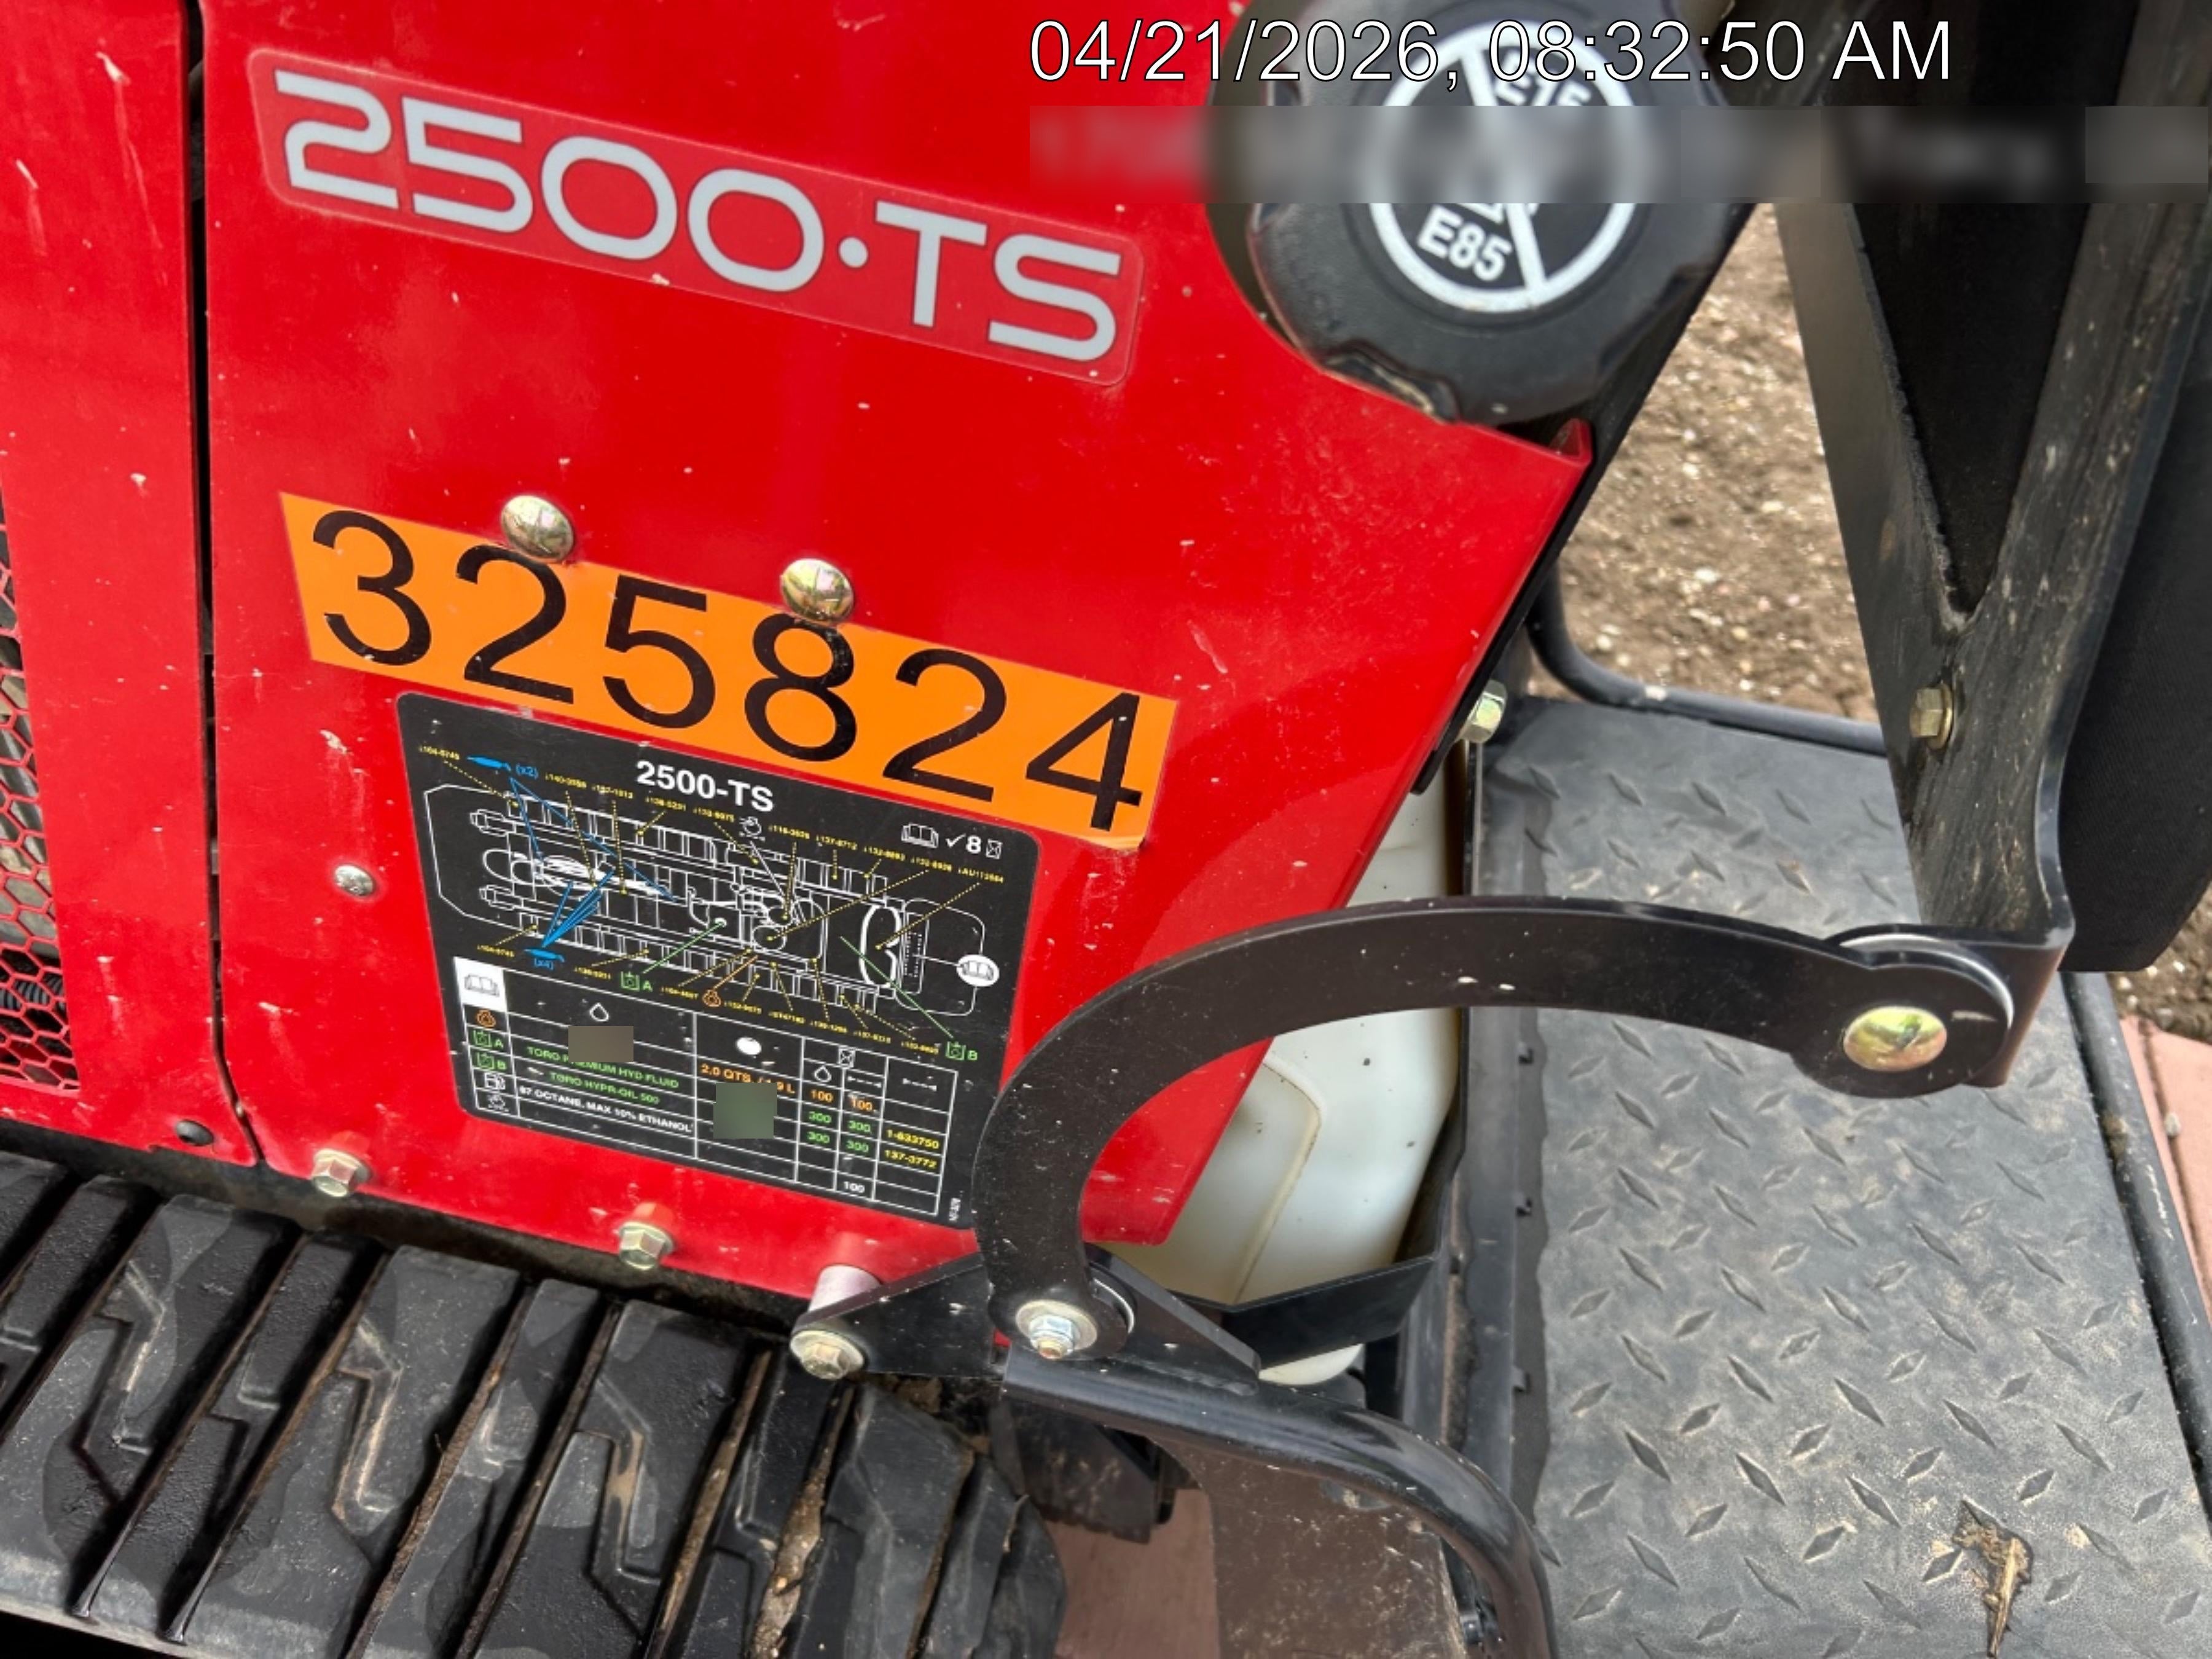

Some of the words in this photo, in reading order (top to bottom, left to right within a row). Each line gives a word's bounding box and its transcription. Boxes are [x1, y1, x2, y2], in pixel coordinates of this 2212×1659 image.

[1416, 205, 1513, 281] E85
[312, 510, 1143, 832] 325824
[516, 764, 539, 779] (x2)
[637, 759, 774, 812] 2500-TS
[965, 834, 982, 853] 8
[643, 982, 653, 992] A
[494, 1038, 504, 1049] A
[967, 1050, 978, 1061] B
[497, 1059, 507, 1070] B
[527, 1046, 560, 1062] TORO
[563, 1053, 616, 1074] EMIUM
[619, 1066, 643, 1080] HYD
[646, 1073, 680, 1089] FLUID
[700, 1063, 720, 1076] 2.0
[550, 1072, 582, 1087] TORO
[584, 1079, 638, 1099] HYPR-OIL
[640, 1092, 660, 1105] 500
[786, 1083, 796, 1094] L
[810, 1089, 833, 1103] 100
[519, 1086, 531, 1096] 87
[586, 1101, 611, 1114] MAX
[615, 1107, 637, 1120] 10%
[638, 1113, 692, 1132] ETHANOL
[850, 1096, 873, 1111] 100
[809, 1110, 831, 1124] 300
[848, 1120, 871, 1133] 300
[807, 1131, 830, 1144] 300
[846, 1140, 869, 1153] 300
[843, 1180, 865, 1193] 100
